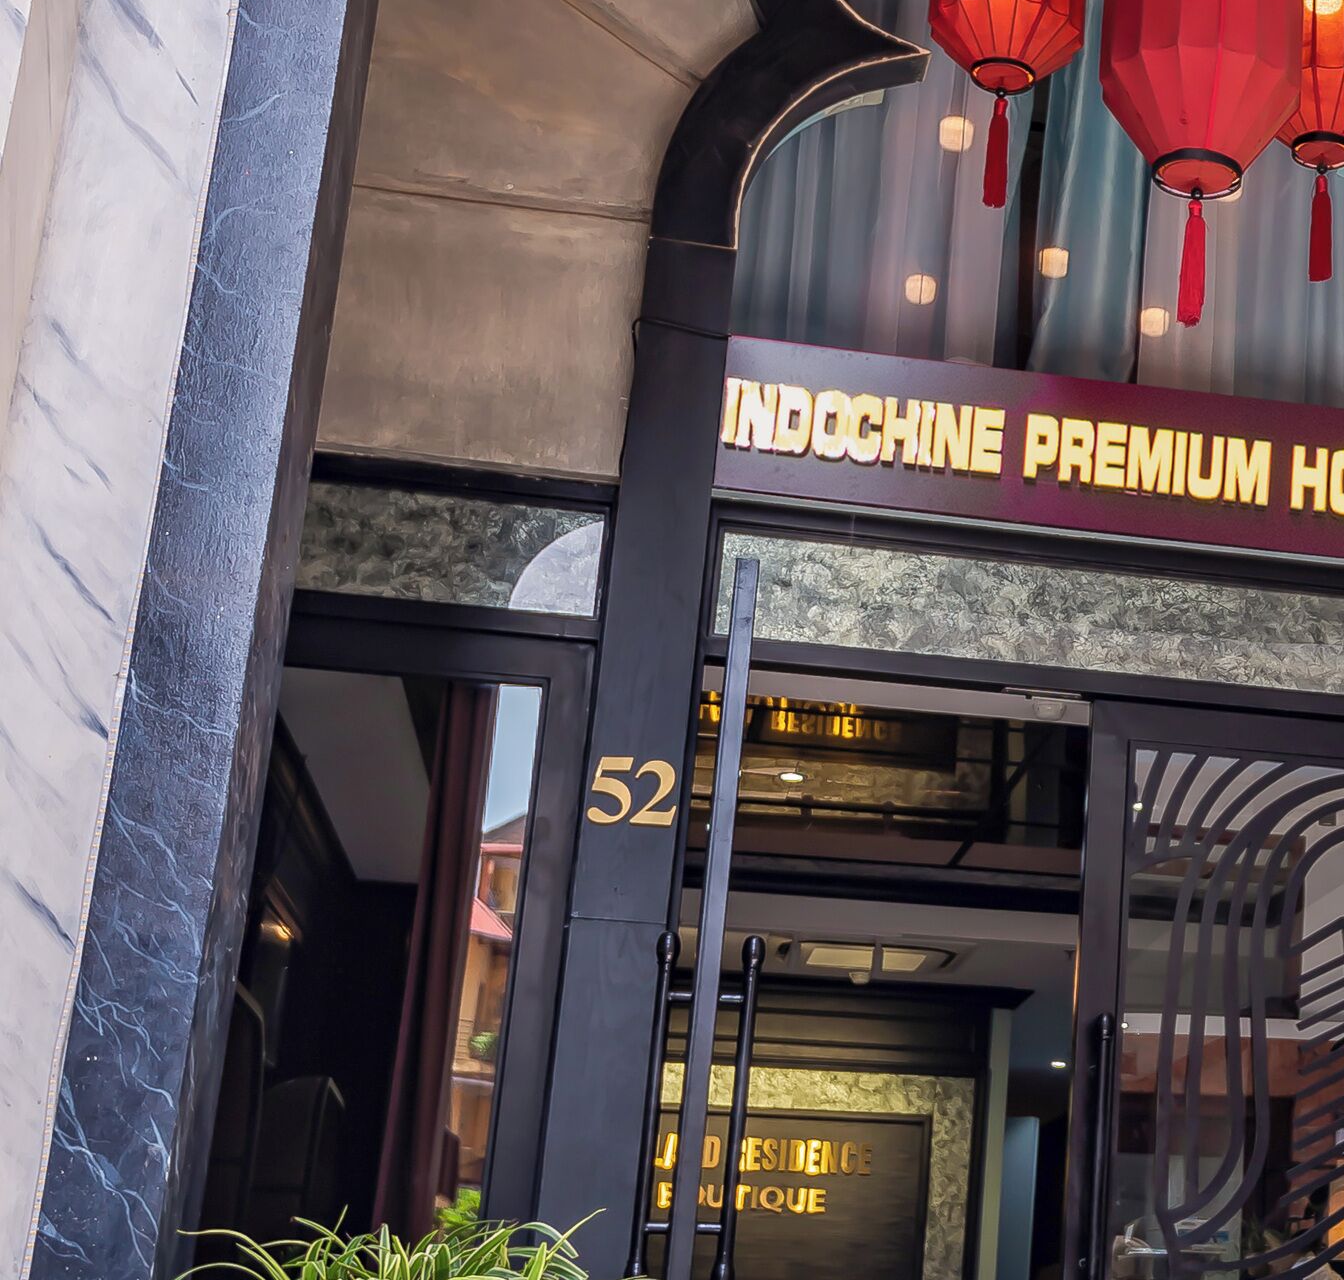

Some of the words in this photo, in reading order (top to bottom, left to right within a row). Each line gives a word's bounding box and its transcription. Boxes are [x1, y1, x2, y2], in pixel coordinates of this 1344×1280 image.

[720, 377, 1006, 477] INDOCHINE
[1022, 412, 1273, 508] PREMIUM
[587, 756, 677, 827] 52
[657, 1182, 828, 1214] BUTIQUE
